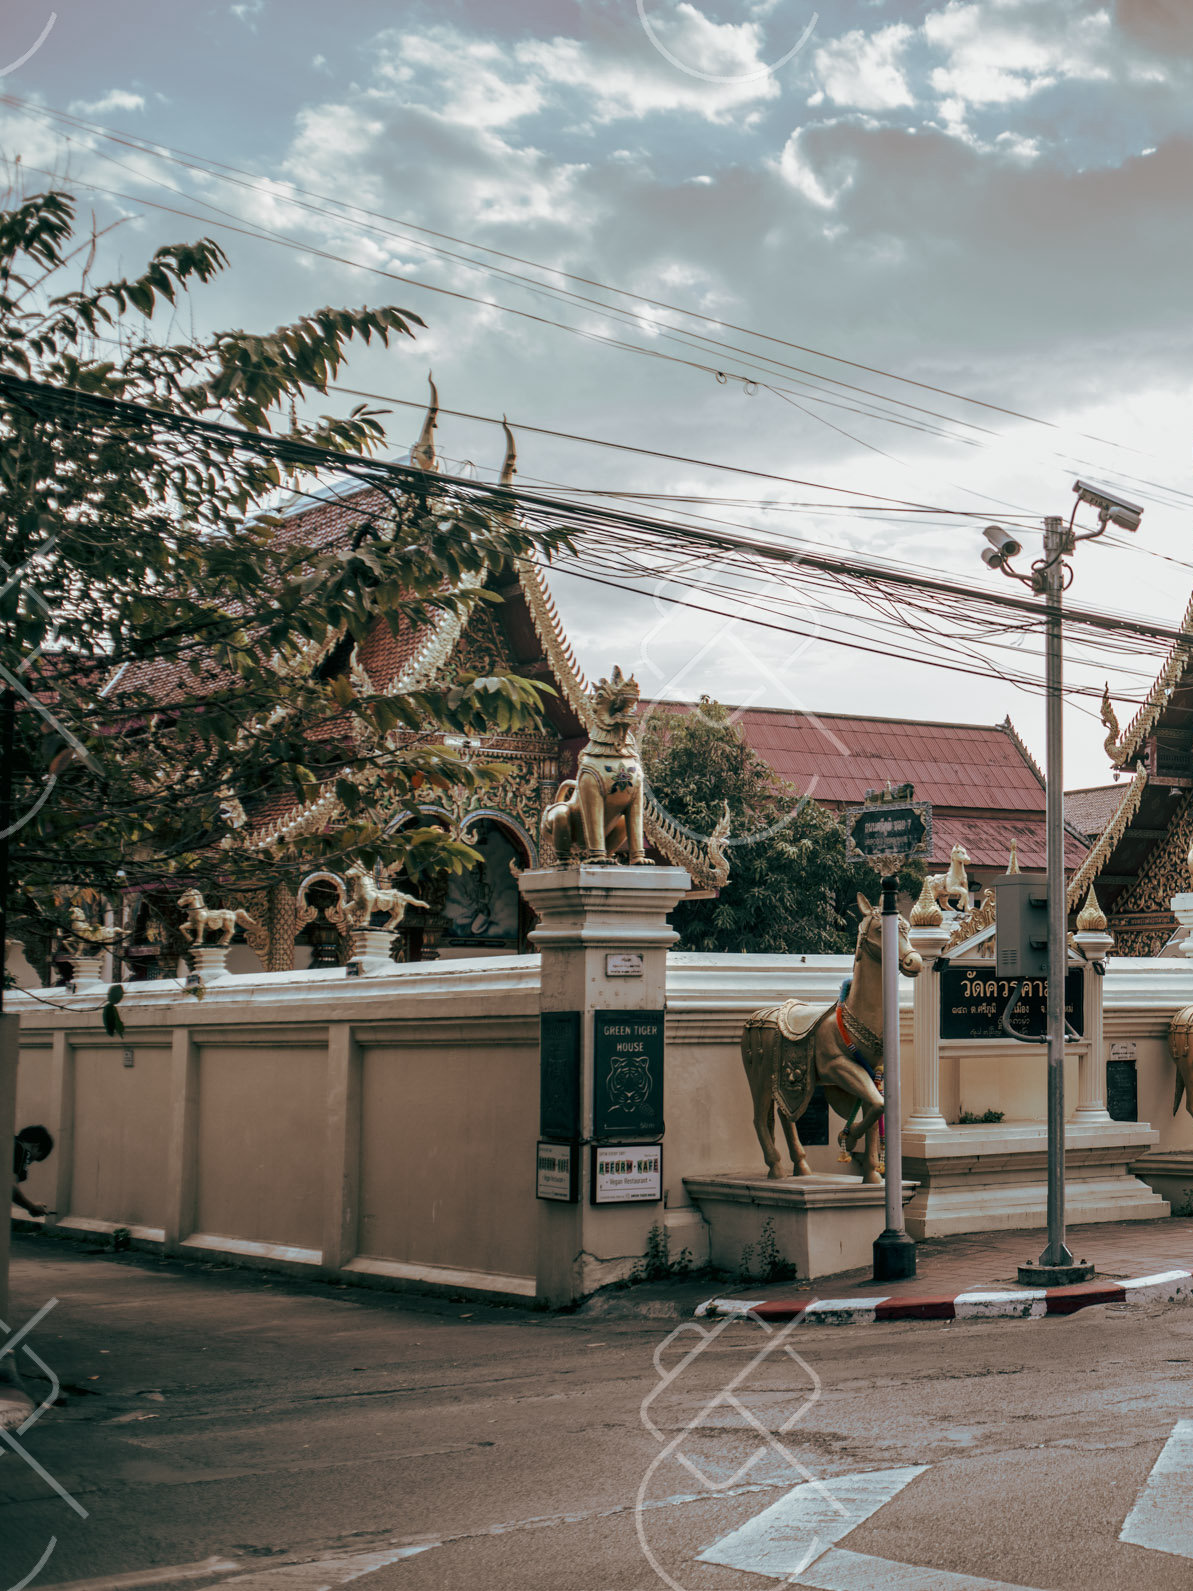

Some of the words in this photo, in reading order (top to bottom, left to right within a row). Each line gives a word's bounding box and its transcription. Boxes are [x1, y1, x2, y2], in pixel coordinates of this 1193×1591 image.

[961, 971, 1048, 998] วัดควรคา
[604, 1025, 631, 1036] GREEN
[634, 1025, 658, 1036] TIGER
[616, 1042, 644, 1052] HOUSE
[600, 1160, 633, 1175] REFORM
[624, 1177, 648, 1185] Restaurant
